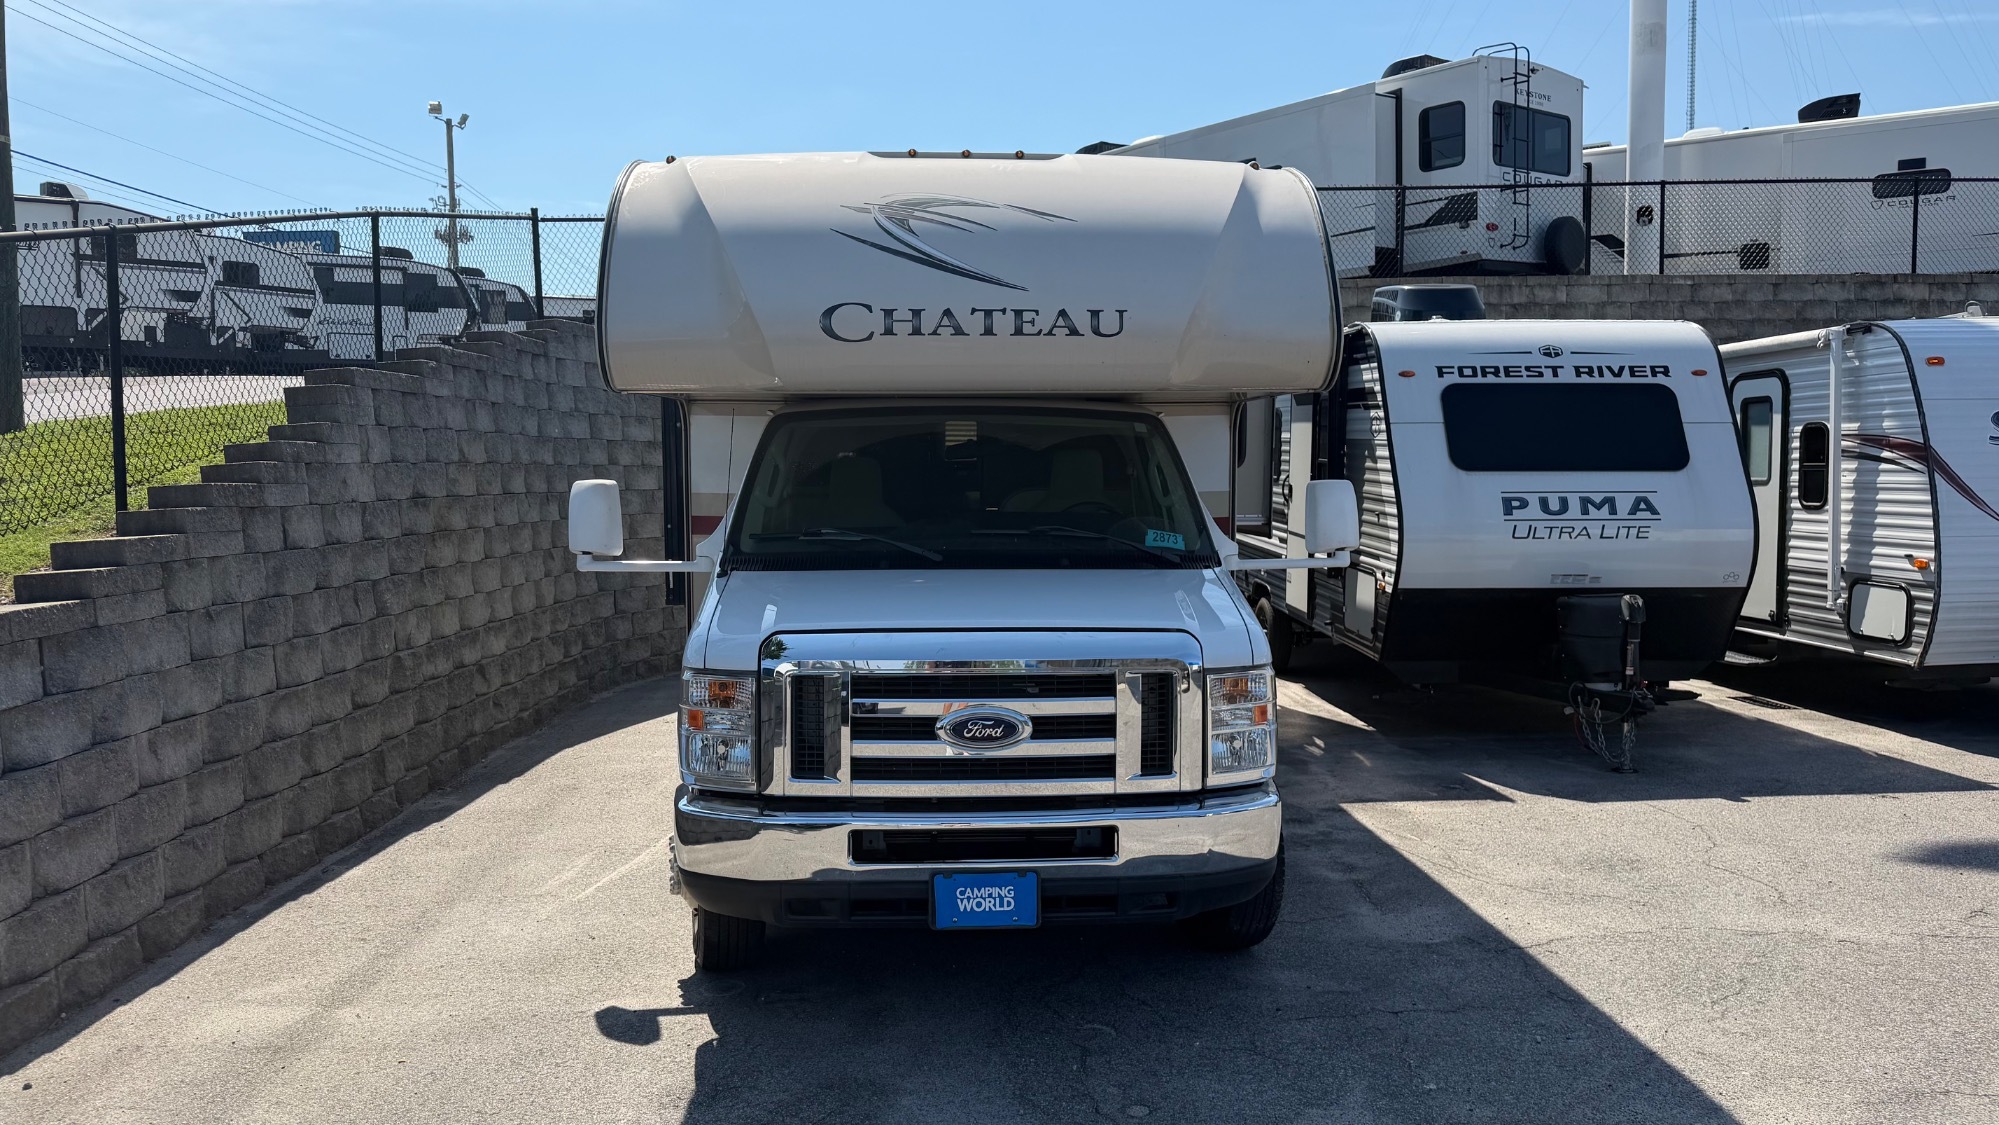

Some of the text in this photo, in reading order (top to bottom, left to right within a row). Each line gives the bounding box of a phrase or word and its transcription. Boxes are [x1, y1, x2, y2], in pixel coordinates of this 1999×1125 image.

[1434, 365, 1672, 378] FOREST RIVER
[1501, 495, 1661, 516] PUMA
[1152, 531, 1179, 545] 2873
[963, 720, 1005, 737] Ford
[956, 886, 1015, 898] CAMPING
[957, 897, 1015, 912] WORLD
